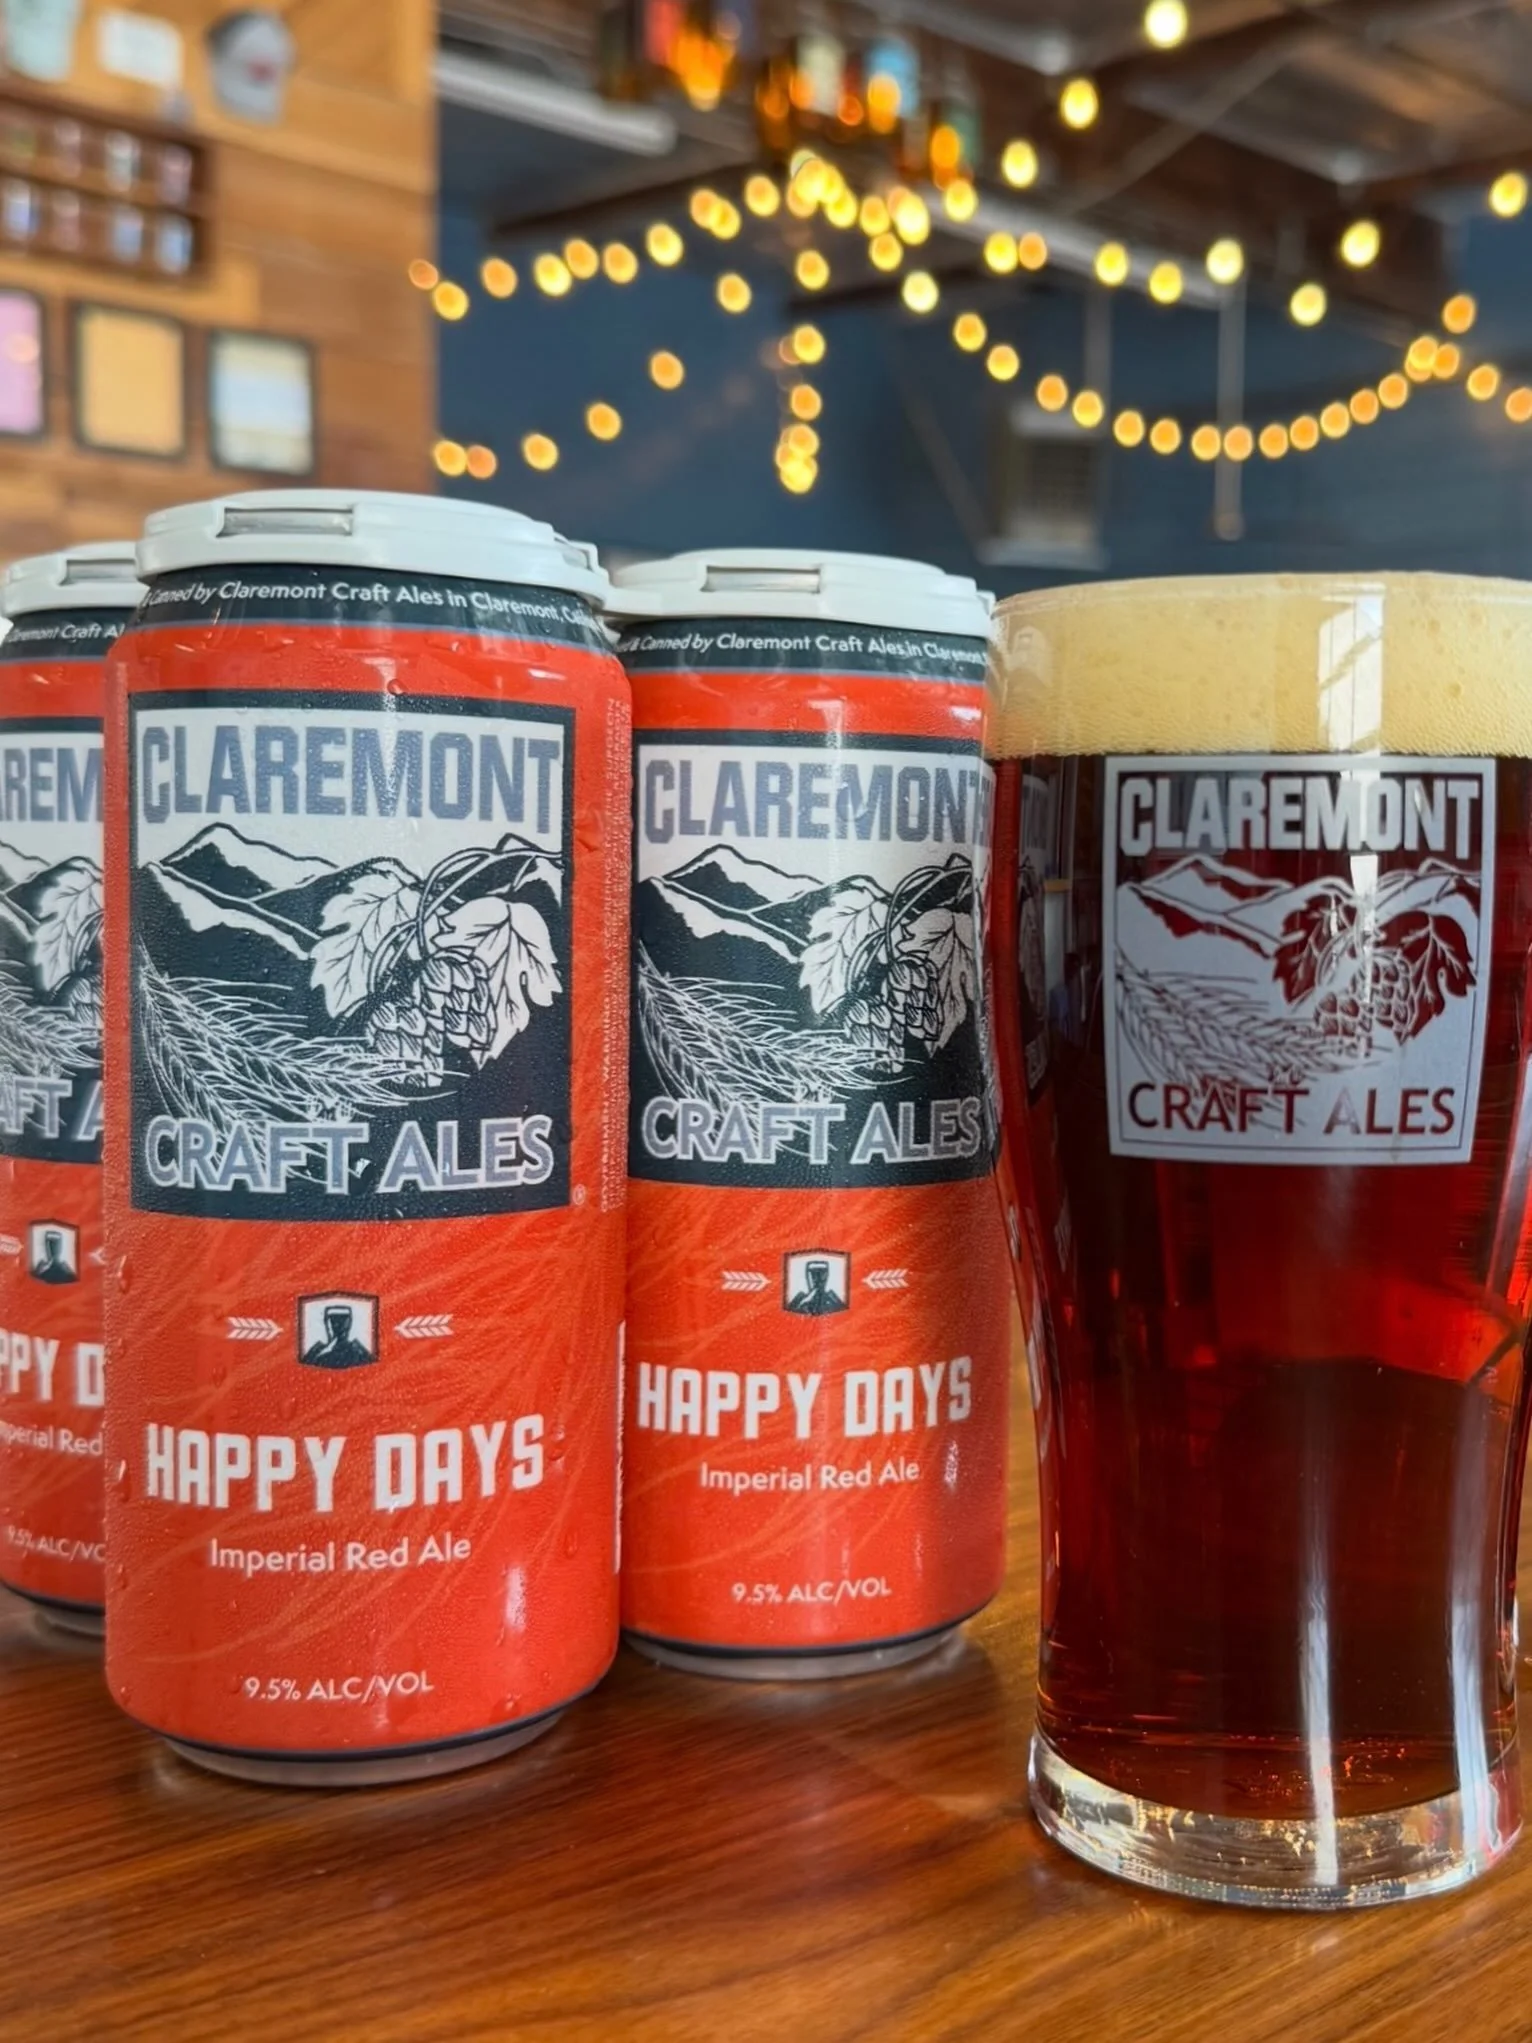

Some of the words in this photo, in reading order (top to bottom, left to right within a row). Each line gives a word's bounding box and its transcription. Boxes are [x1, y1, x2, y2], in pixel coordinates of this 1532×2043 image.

[194, 582, 217, 605] by
[219, 581, 326, 600] Claremont
[331, 582, 391, 602] Craft
[396, 585, 444, 607] Ales
[449, 589, 468, 609] in
[61, 623, 101, 640] Craft
[641, 633, 692, 651] Canned
[691, 633, 714, 653] by
[716, 632, 811, 650] Claremont
[815, 635, 863, 652] Craft
[868, 637, 905, 656] Ales
[906, 640, 923, 658] in
[143, 724, 560, 834] CLAREMONT
[1120, 777, 1479, 859] CLAREMONT
[642, 1096, 846, 1165] CRAFT
[850, 1096, 981, 1165] ALES
[1129, 1083, 1309, 1135] CRAFT
[1324, 1087, 1456, 1136] ALES
[145, 1114, 369, 1194] CRAFT
[376, 1114, 555, 1193] ALES
[637, 1362, 821, 1440] HAPPY
[844, 1355, 972, 1438] DAYS
[60, 1428, 103, 1457] Red
[146, 1422, 347, 1513] HAPPY
[374, 1413, 545, 1511] DAYS
[701, 1462, 811, 1496] Imperial
[820, 1462, 871, 1490] Red
[879, 1456, 920, 1484] Ale
[210, 1538, 335, 1577] Imperial
[346, 1541, 409, 1570] Red
[419, 1532, 471, 1562] Ale
[731, 1581, 783, 1604] 9.5%
[787, 1576, 891, 1605] ALC/VOL
[244, 1676, 301, 1701] 9.5%
[307, 1671, 435, 1702] ALC/VOL
